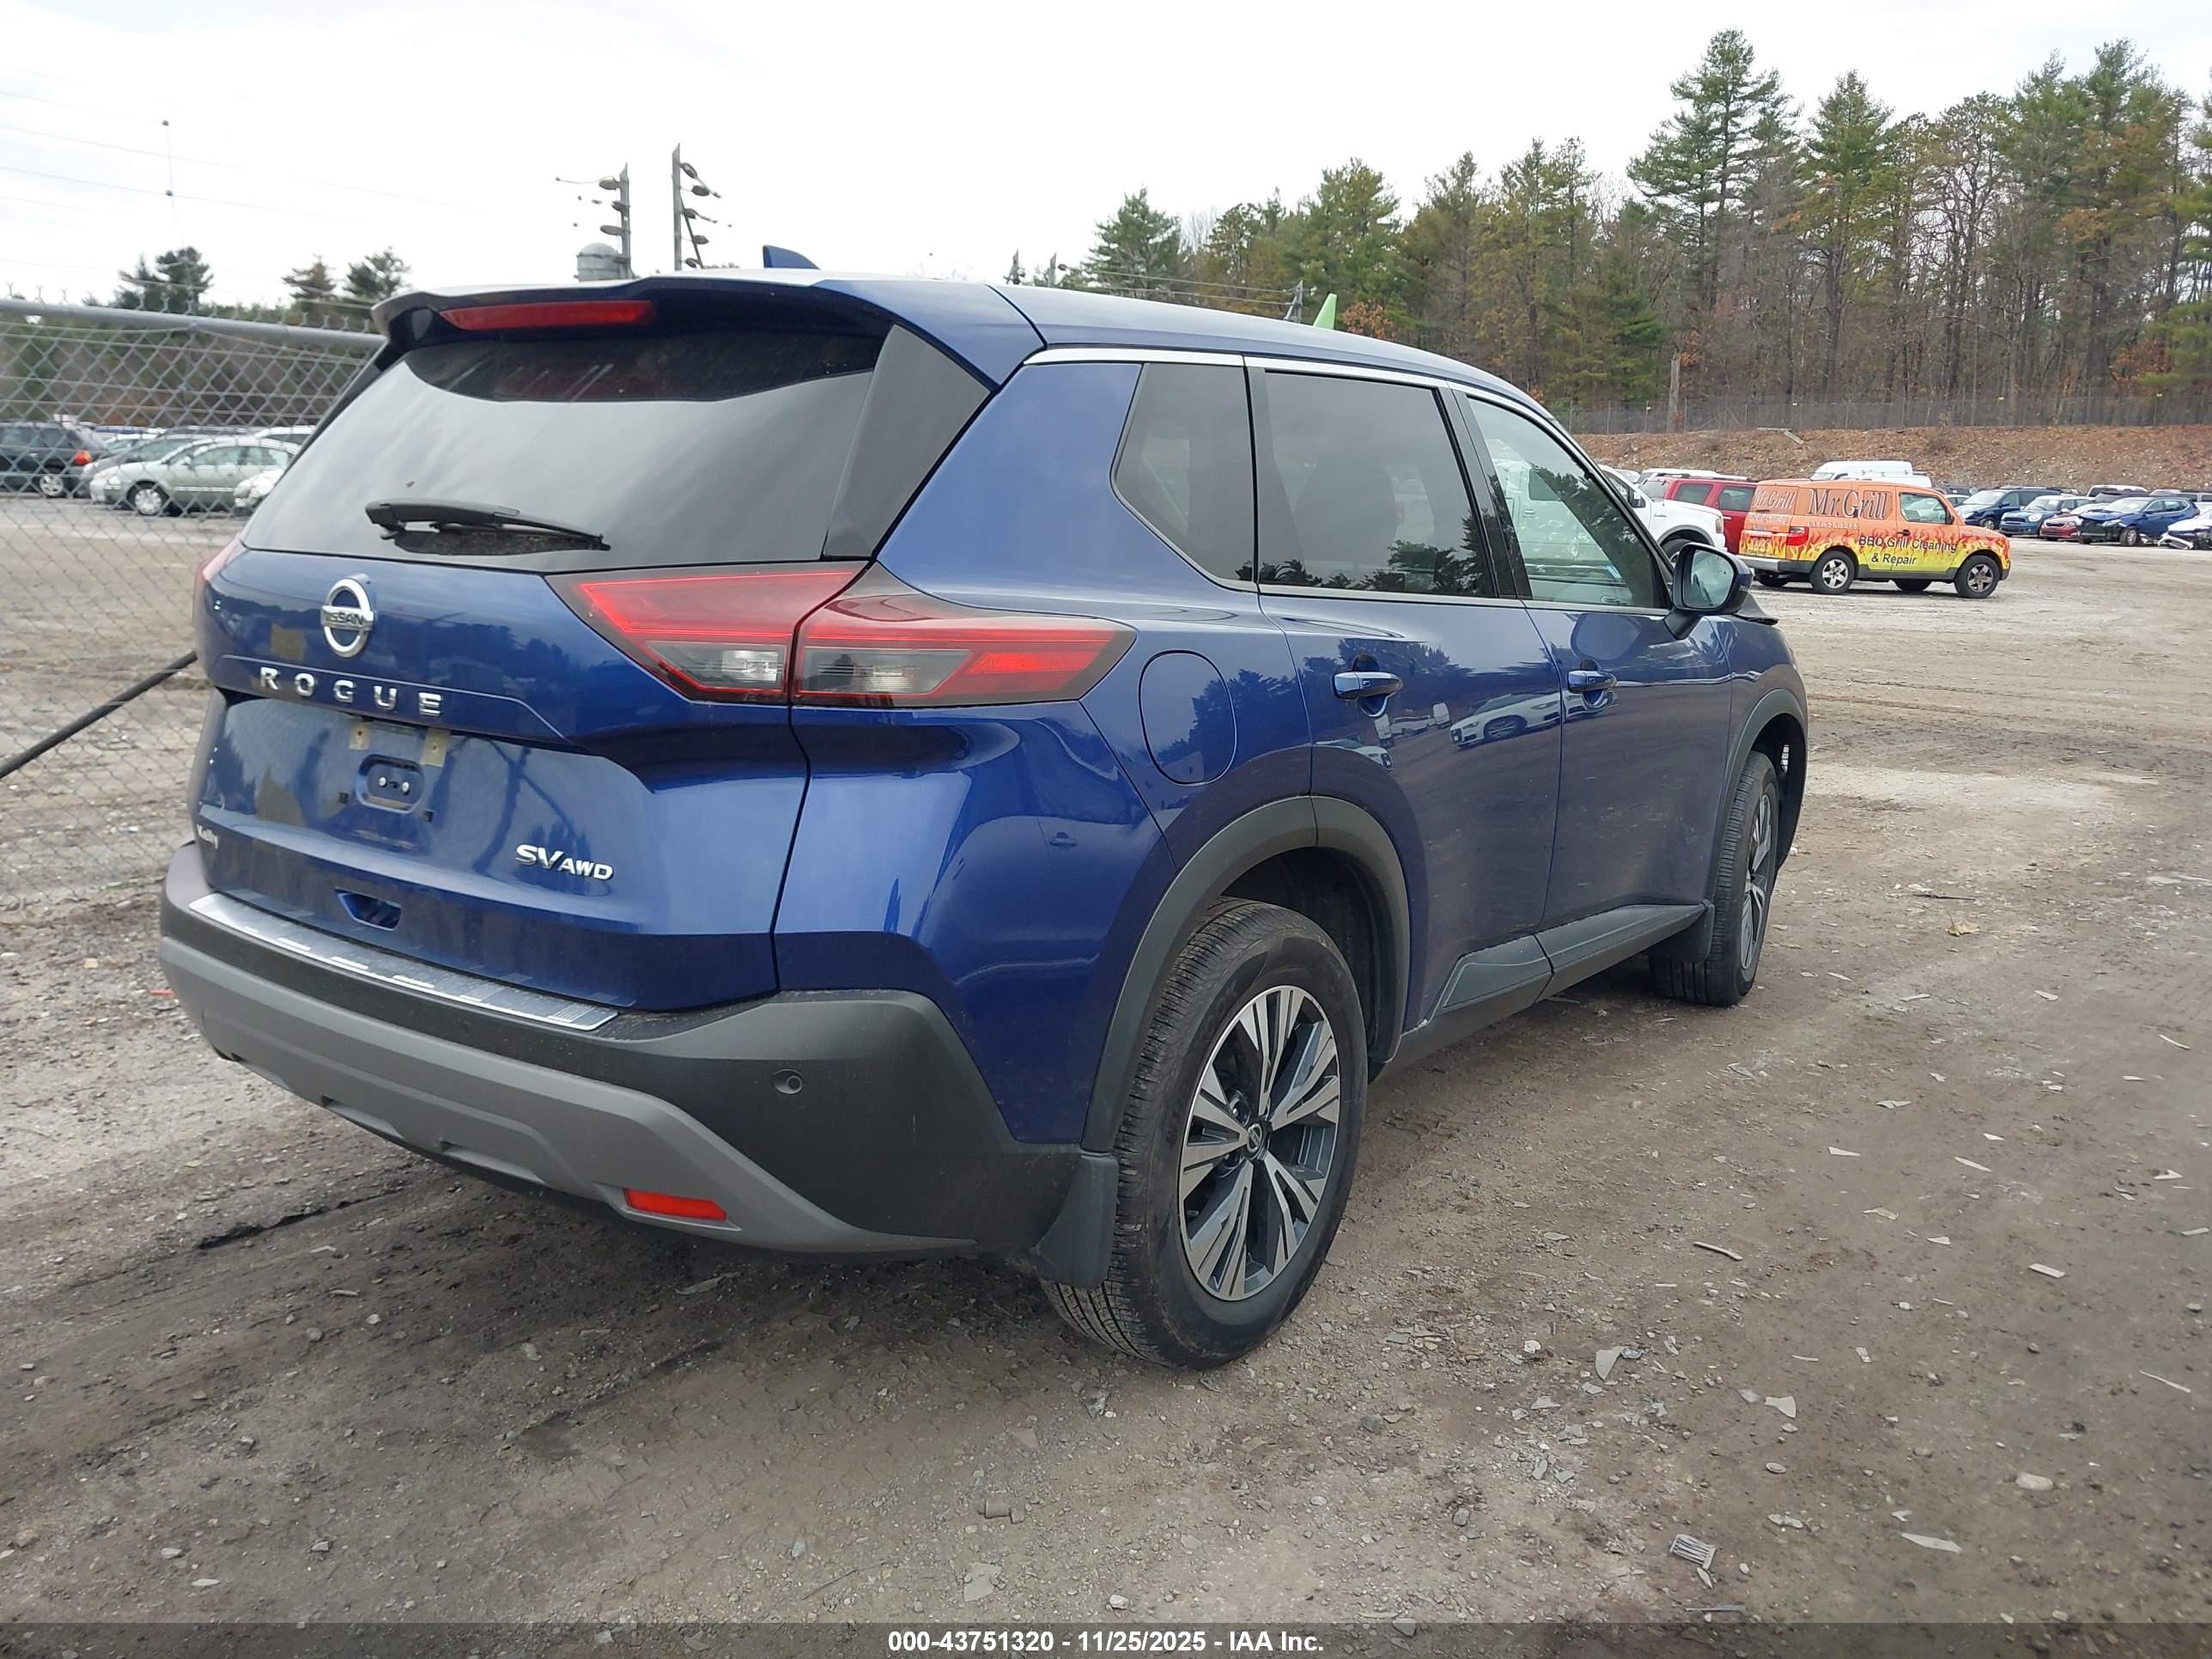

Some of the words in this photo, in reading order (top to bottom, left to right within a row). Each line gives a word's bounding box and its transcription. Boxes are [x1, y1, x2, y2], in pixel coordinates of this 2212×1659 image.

[1858, 535, 1885, 548] BBQ
[1887, 536, 1909, 549] Grill
[1911, 538, 1958, 554] Cleaning
[1871, 552, 1879, 563] &
[1882, 553, 1917, 567] Repair
[259, 665, 443, 717] ROGUE
